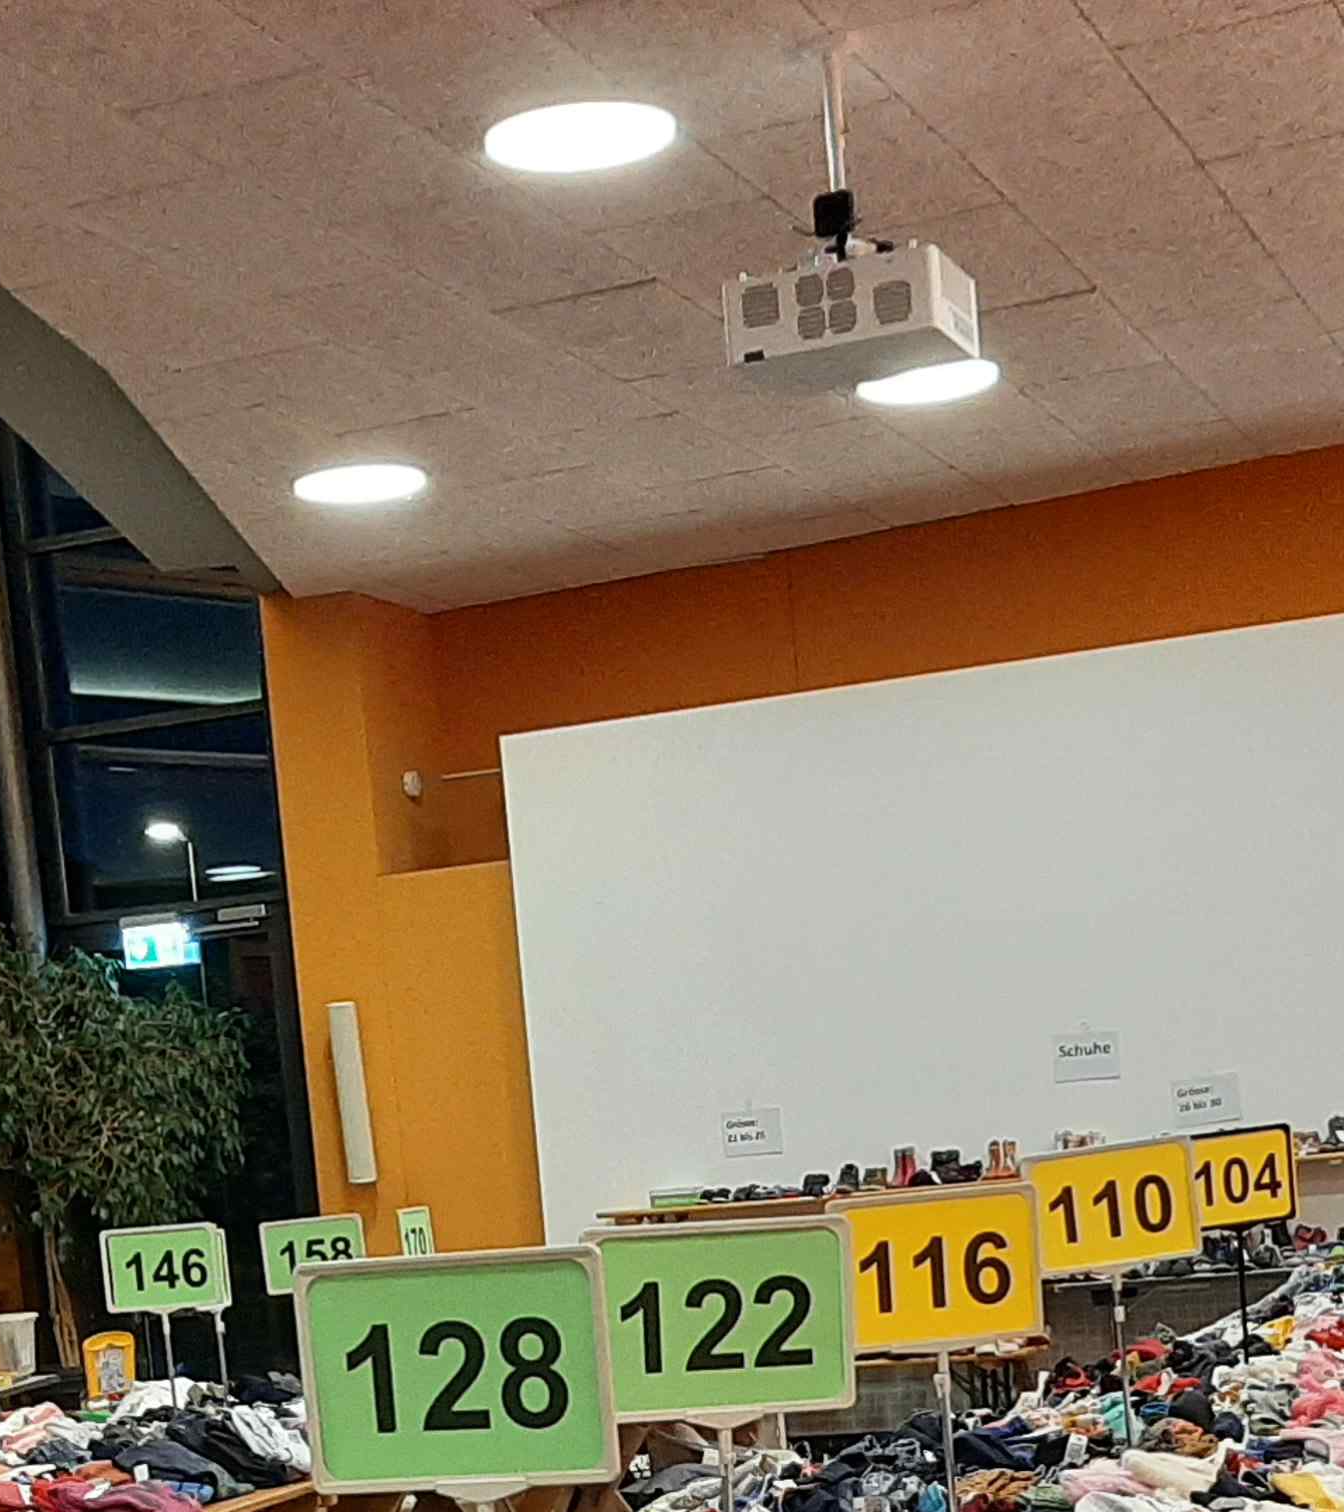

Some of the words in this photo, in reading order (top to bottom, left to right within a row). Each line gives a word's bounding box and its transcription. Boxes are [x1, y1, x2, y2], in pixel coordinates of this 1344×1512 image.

[1058, 1041, 1112, 1058] Schuhe
[1049, 1174, 1173, 1244] 110
[1193, 1152, 1283, 1207] 104
[125, 1247, 208, 1292] 146
[859, 1230, 1011, 1314] 116
[620, 1274, 815, 1375] 122
[344, 1316, 571, 1435] 128
